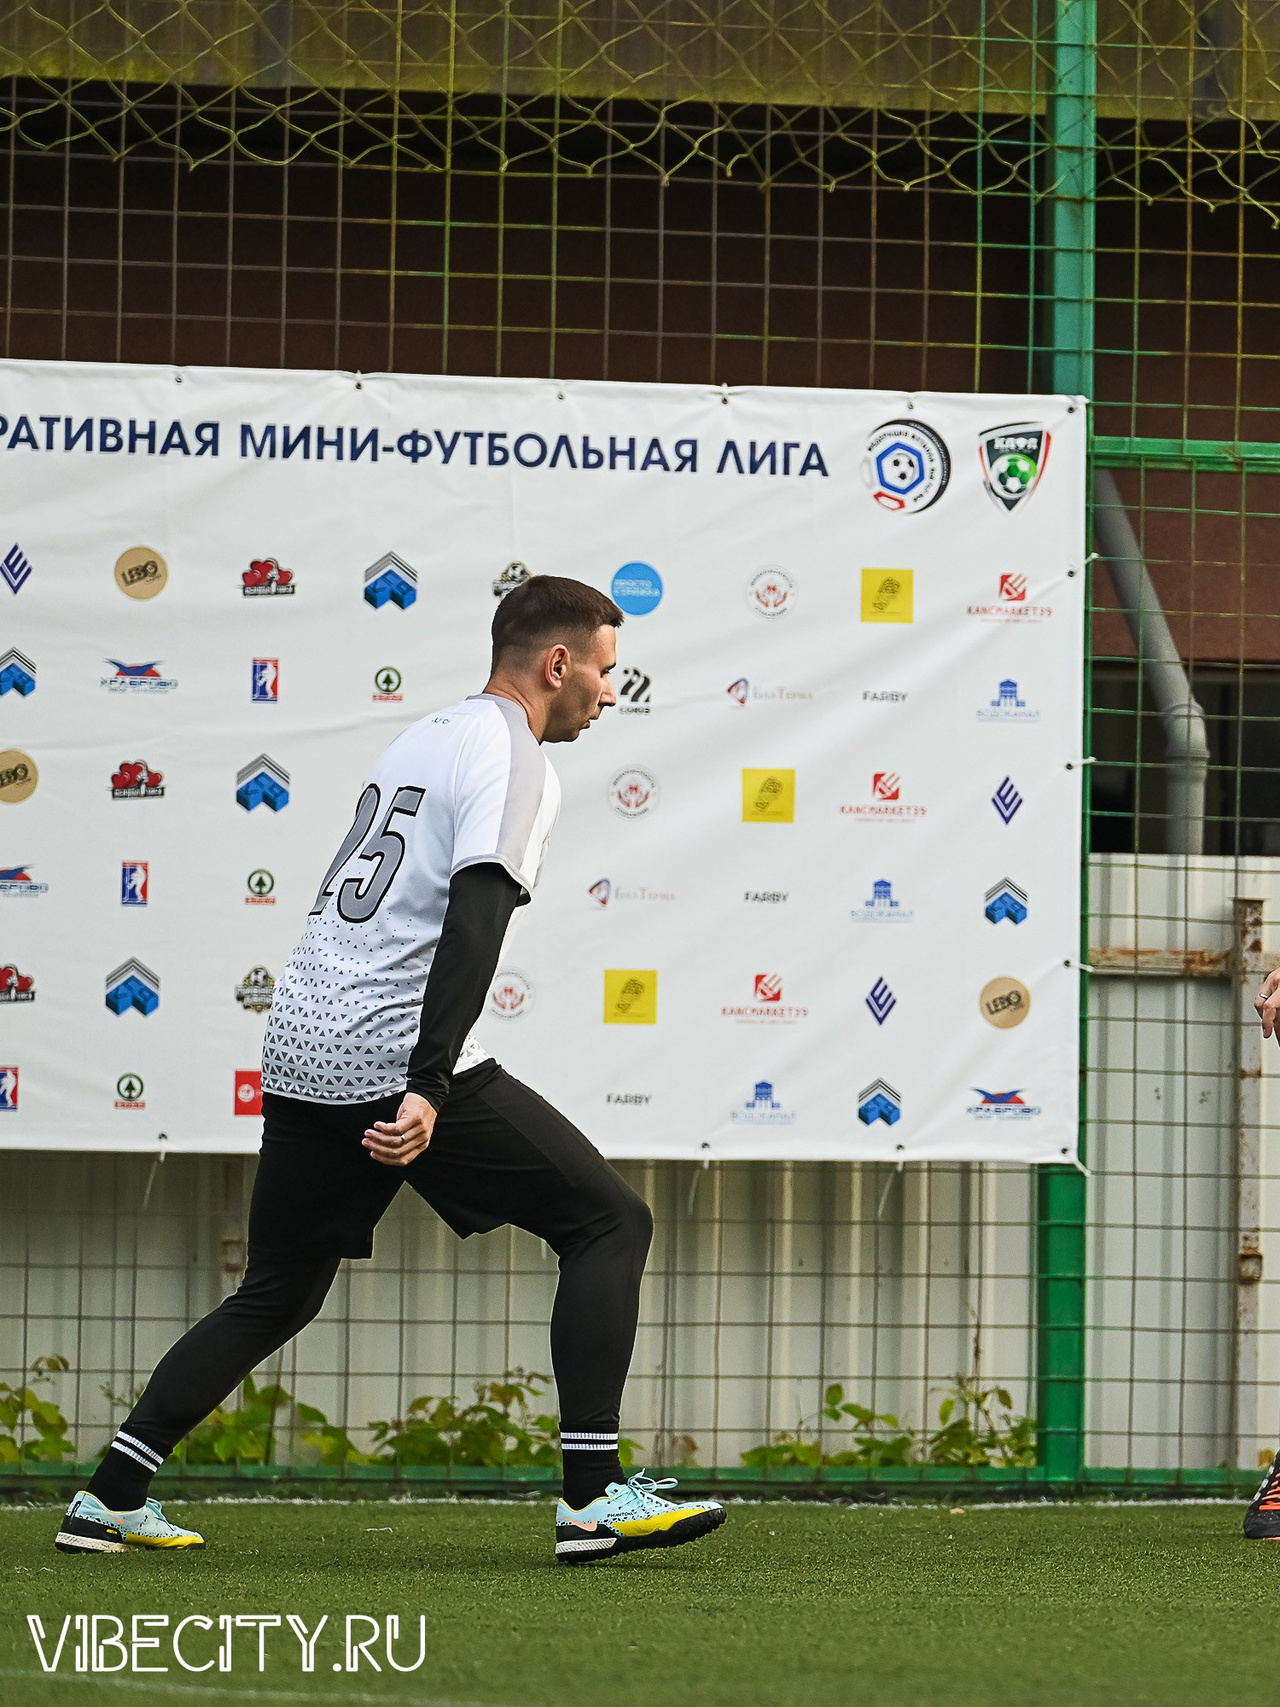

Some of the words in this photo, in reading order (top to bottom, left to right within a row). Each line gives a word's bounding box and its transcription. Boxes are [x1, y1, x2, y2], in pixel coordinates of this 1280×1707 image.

[240, 423, 698, 473] МИНИ-ФУТБОЛЬНАЯ
[716, 440, 829, 477] ЛИГА
[308, 783, 426, 923] 25
